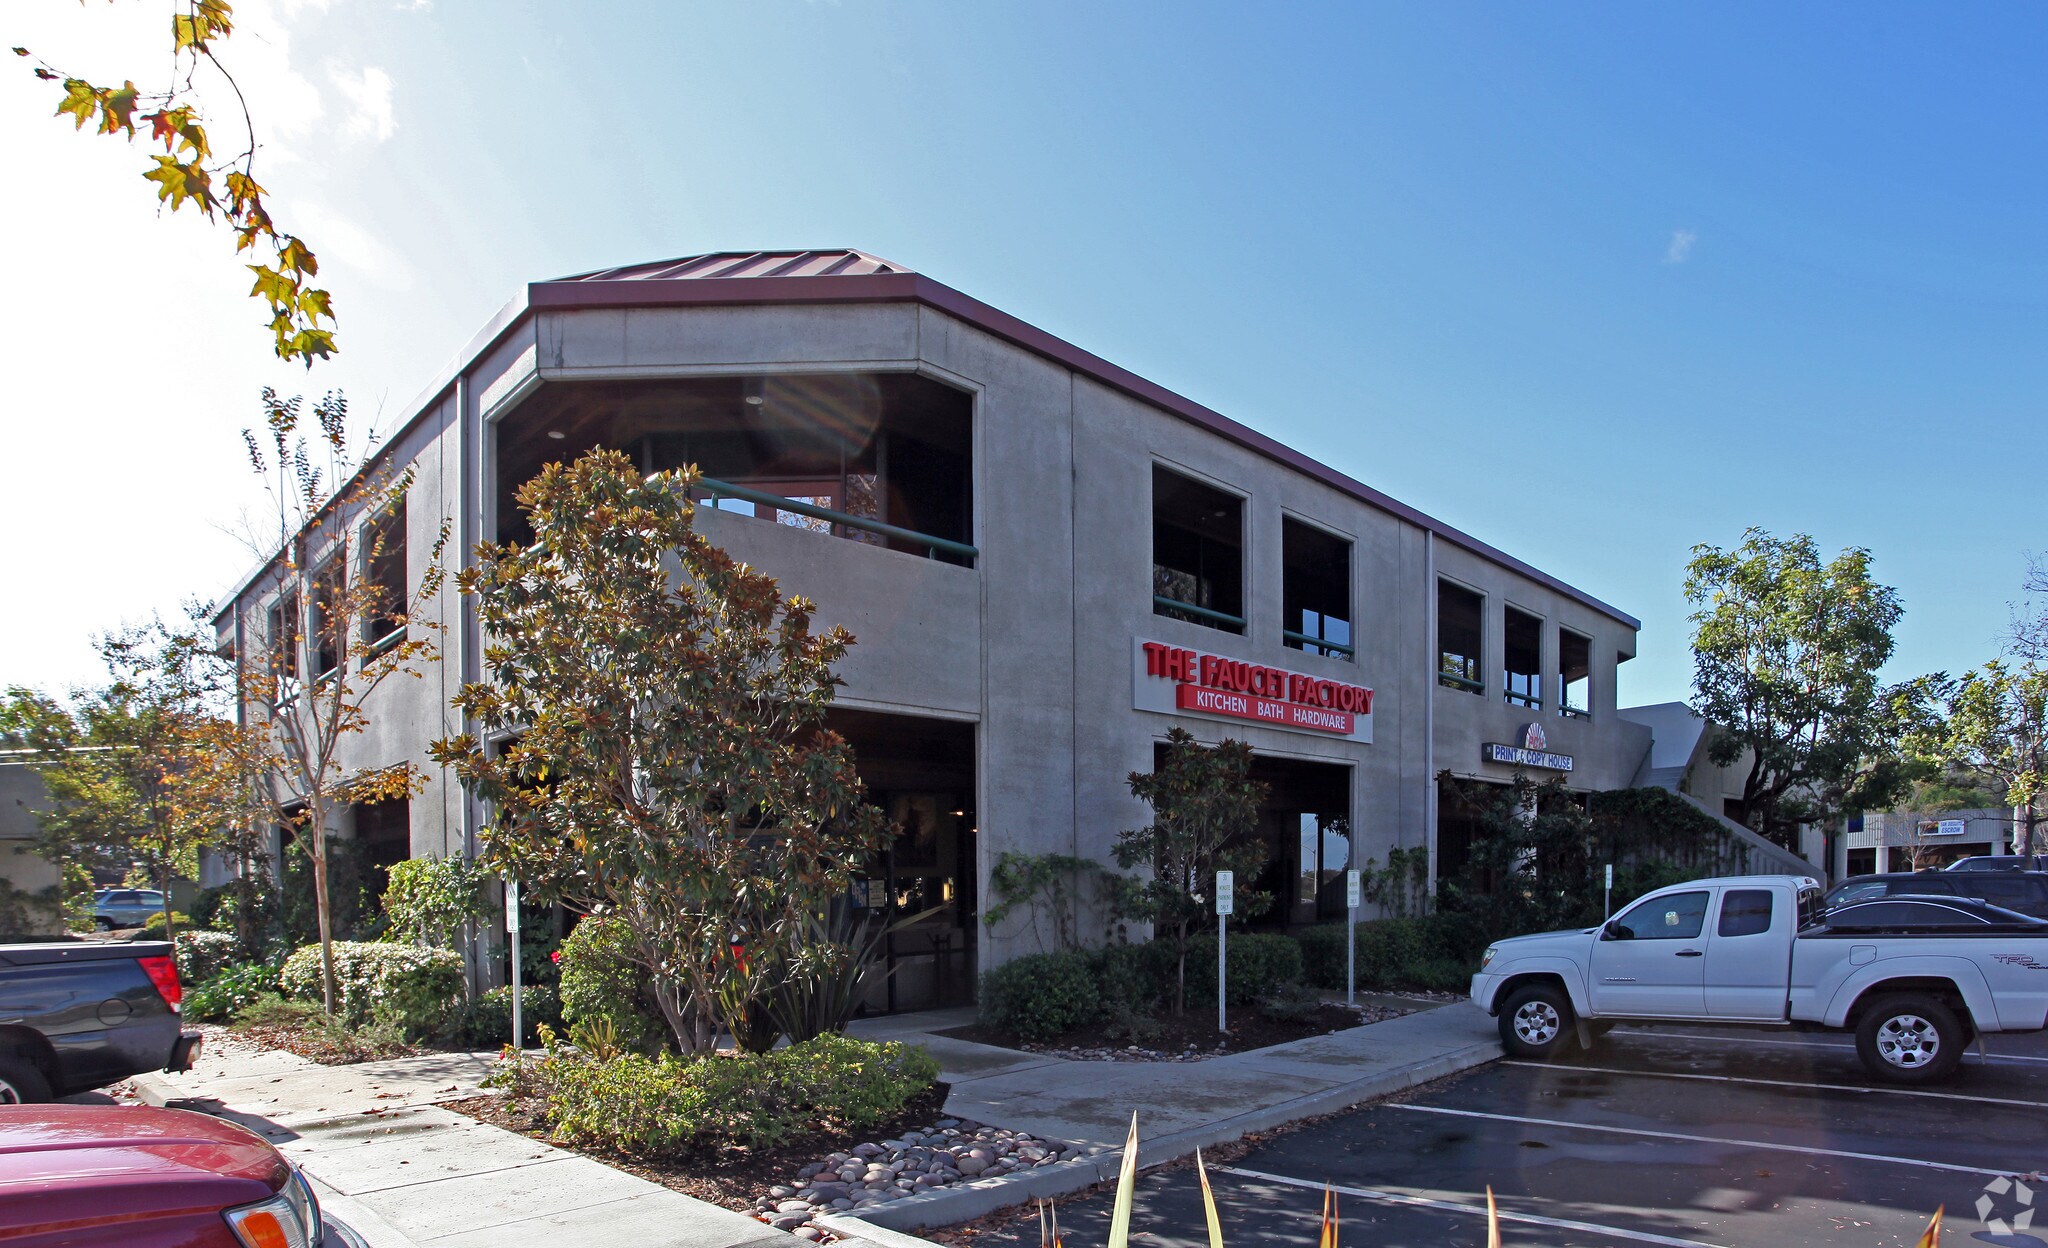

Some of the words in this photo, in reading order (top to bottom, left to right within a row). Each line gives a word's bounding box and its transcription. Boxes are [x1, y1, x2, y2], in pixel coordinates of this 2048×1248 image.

[1143, 642, 1197, 683] THE
[1200, 655, 1288, 699] FAUCET
[1289, 674, 1375, 714] FACTORY
[1197, 690, 1247, 714] KITCHEN
[1257, 702, 1284, 720] BATH
[1293, 708, 1346, 730] HARDWARE
[1495, 745, 1518, 761] PRINT
[1526, 750, 1546, 766] COPY
[1548, 755, 1571, 769] HOUSE
[1994, 955, 2034, 965] TRD
